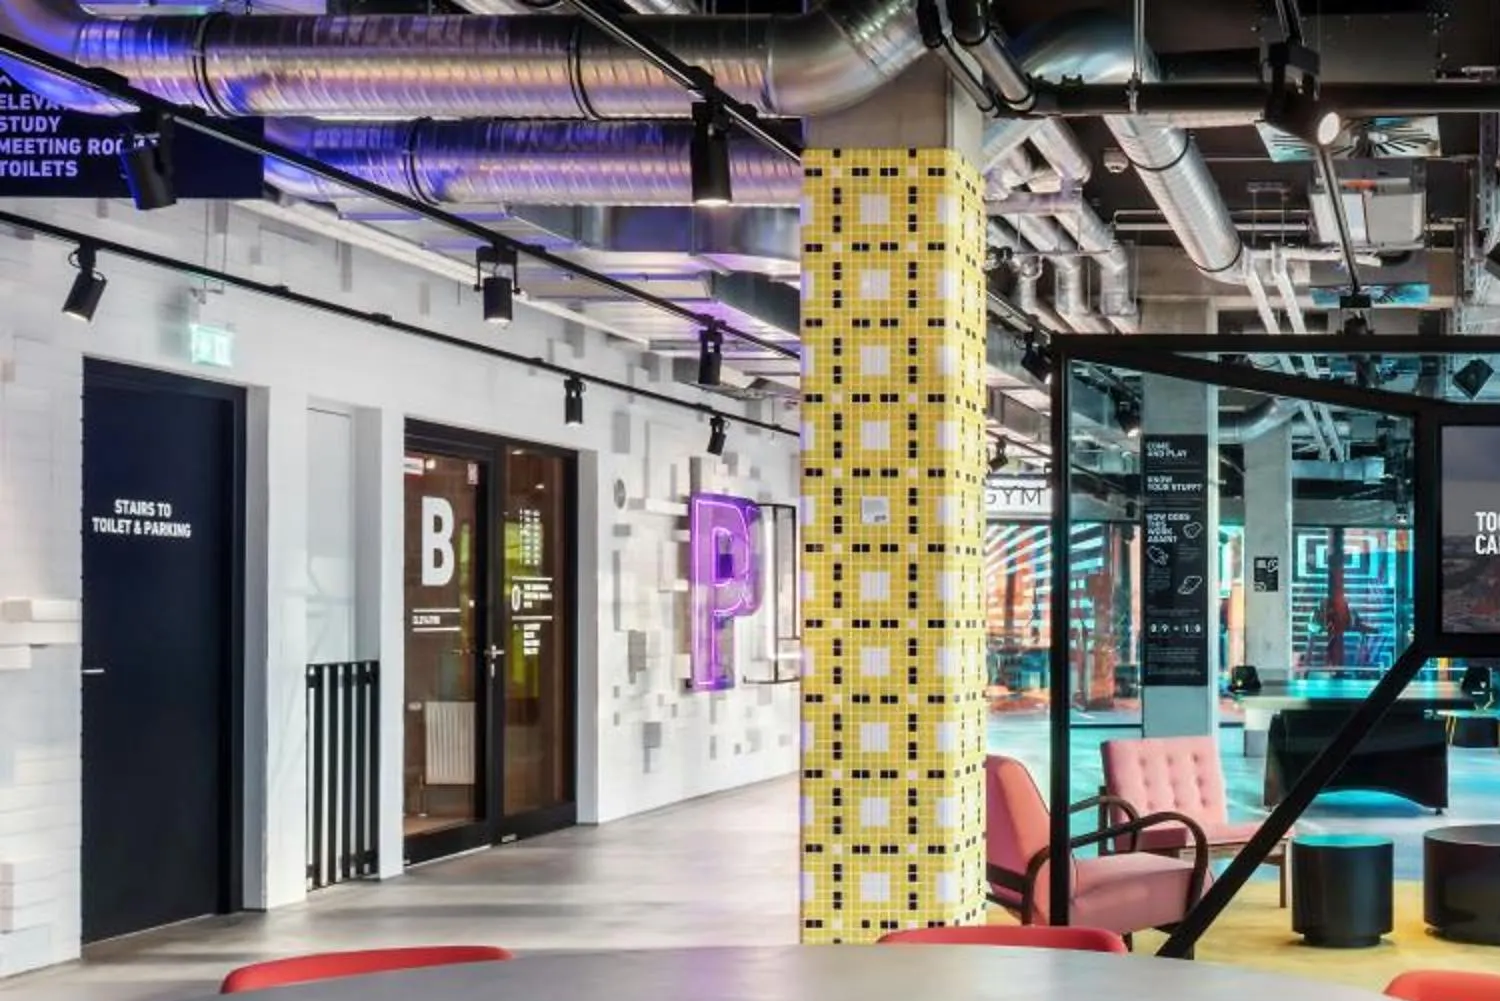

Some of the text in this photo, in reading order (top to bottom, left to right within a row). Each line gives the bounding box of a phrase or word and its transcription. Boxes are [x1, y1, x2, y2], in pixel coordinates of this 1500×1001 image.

[0, 93, 67, 110] ELEVA
[0, 115, 61, 132] STUDY
[0, 137, 82, 155] MEETING
[0, 159, 78, 177] TOILETS
[1166, 450, 1188, 458] PLAY
[114, 499, 172, 518] STAIRS TO
[91, 517, 192, 538] TOILET & PARKING
[421, 495, 455, 587] B
